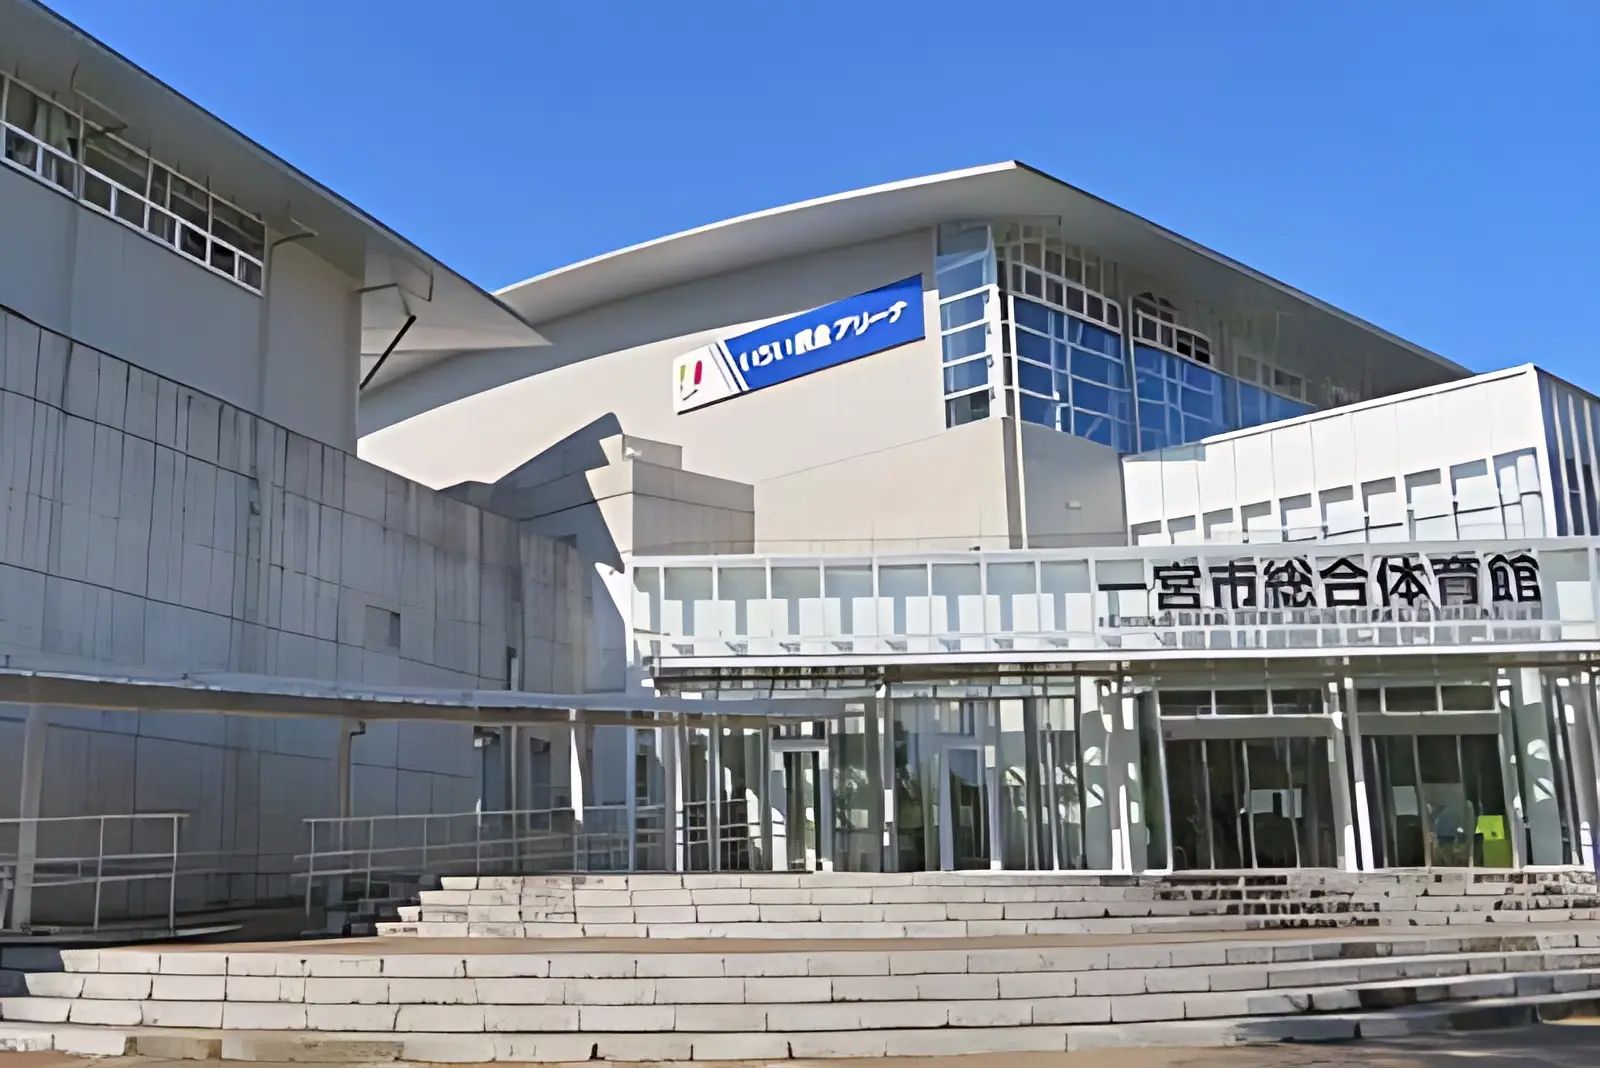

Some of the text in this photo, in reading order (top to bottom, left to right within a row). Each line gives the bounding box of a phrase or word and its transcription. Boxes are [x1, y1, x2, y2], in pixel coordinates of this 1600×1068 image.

[739, 300, 908, 371] いちいアリーナ
[1098, 553, 1540, 610] 一宮市総合体育館
